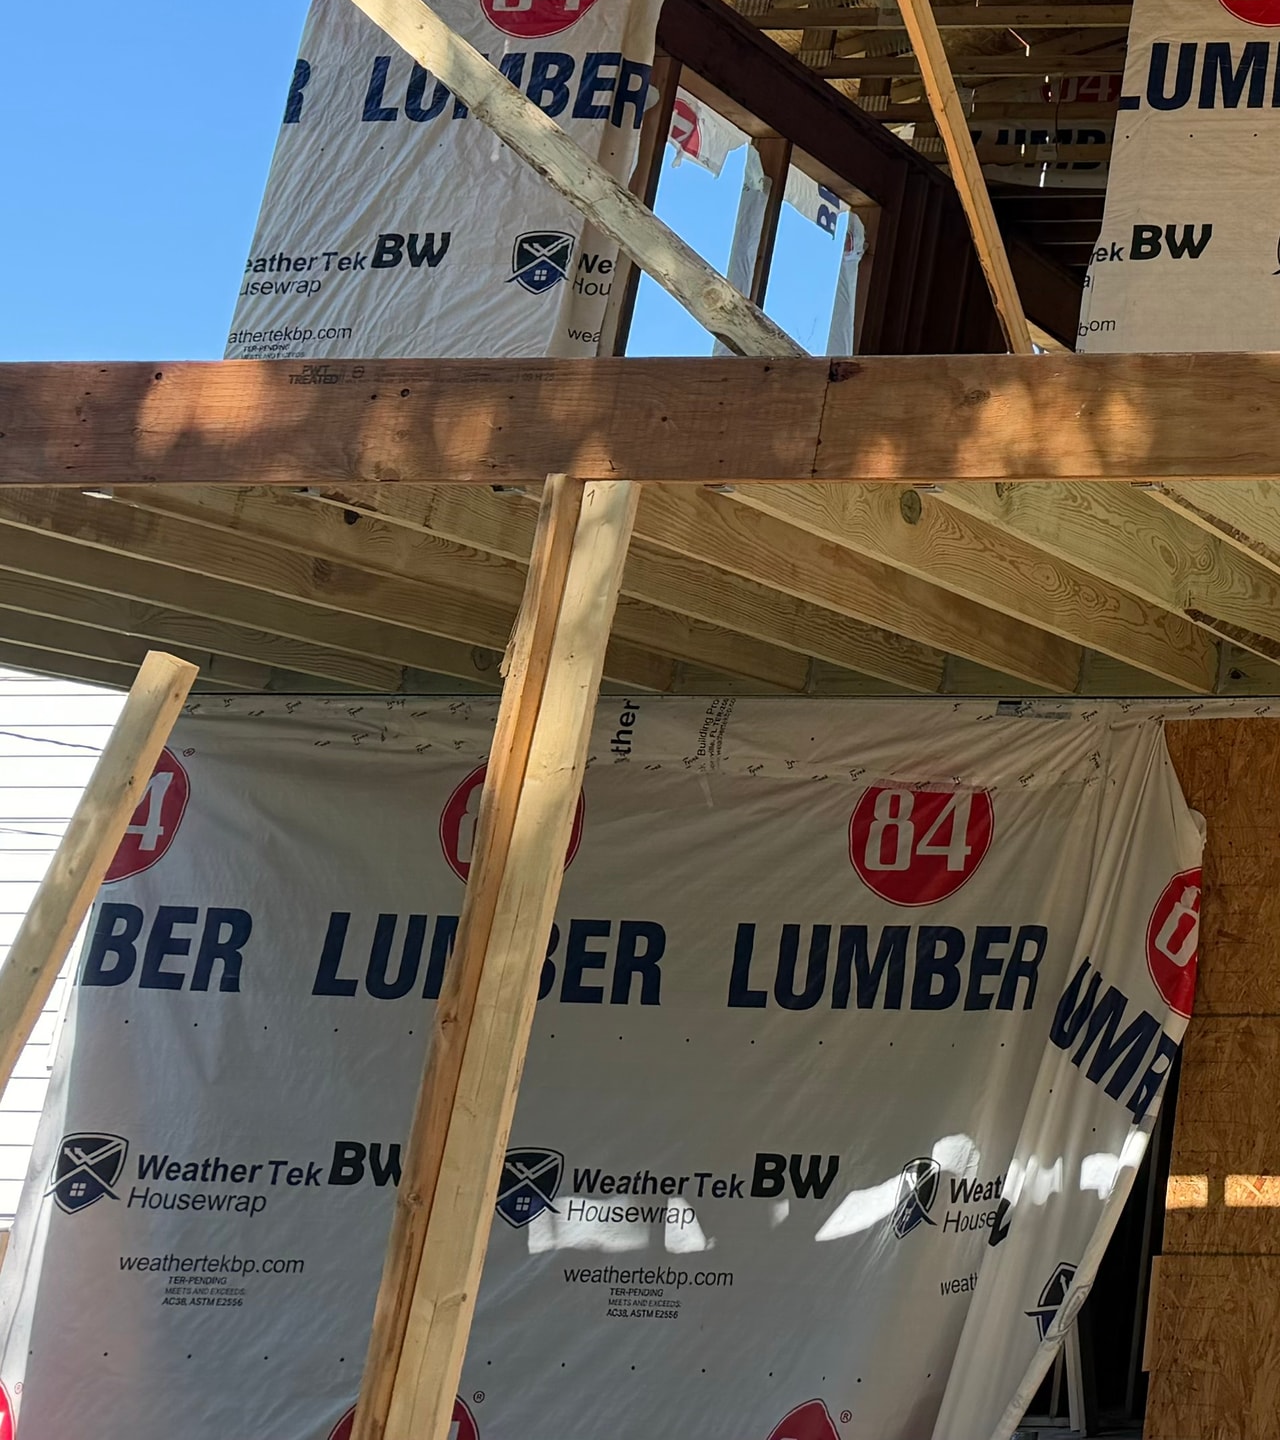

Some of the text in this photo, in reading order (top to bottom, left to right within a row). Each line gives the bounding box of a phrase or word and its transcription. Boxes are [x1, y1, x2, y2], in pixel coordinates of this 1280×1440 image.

[322, 231, 451, 272] Tek BW
[1129, 223, 1213, 261] BW
[696, 714, 714, 757] Building
[865, 788, 973, 872] 84
[727, 922, 1048, 1011] LUMBER
[137, 1154, 265, 1184] Weather
[268, 1160, 323, 1187] Tek
[573, 1152, 840, 1200] Weather Tek BW
[126, 1186, 267, 1218] Housewrap
[567, 1199, 696, 1230] Housewrap
[119, 1253, 305, 1277] weathertekbp.com
[564, 1265, 734, 1289] weathertekbp.com
[164, 1287, 192, 1296] MEETS
[168, 1276, 228, 1286] TER-PENDING
[609, 1287, 664, 1297] TER-PENDING
[188, 1297, 215, 1307] ASTM
[215, 1297, 244, 1307] E2556
[607, 1298, 632, 1307] MEETS
[630, 1308, 679, 1320] ASTM E2556
